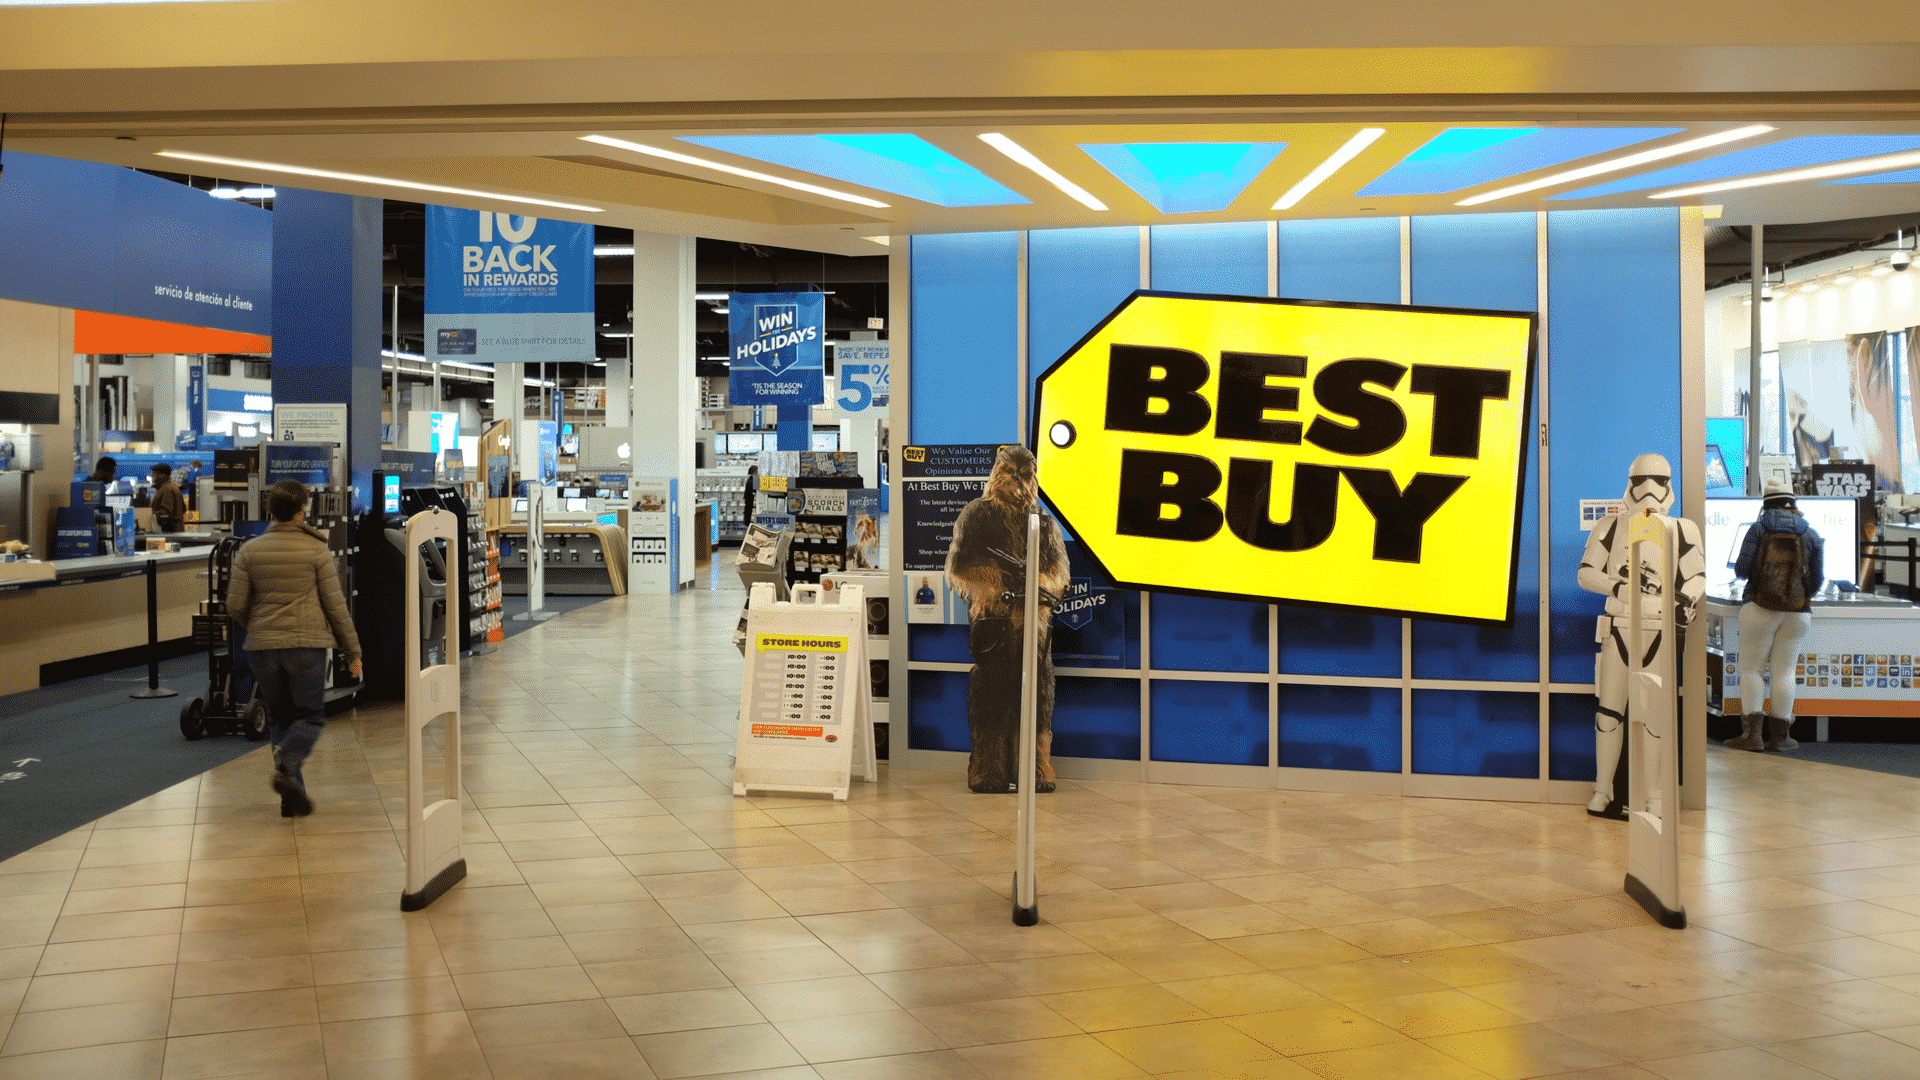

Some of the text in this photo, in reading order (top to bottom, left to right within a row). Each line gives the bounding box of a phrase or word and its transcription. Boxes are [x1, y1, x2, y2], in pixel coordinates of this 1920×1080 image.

[479, 210, 537, 243] 10
[463, 244, 558, 273] BACK
[463, 273, 559, 286] IN REWARDS
[155, 284, 253, 311] servicio de atención al cliente
[759, 311, 793, 332] WIN
[736, 326, 817, 360] HOLIDAYS
[863, 352, 890, 360] REPEA
[1104, 343, 1512, 460] BEST
[931, 447, 992, 455] We Value Our
[930, 457, 992, 465] CUSTOMERS
[925, 467, 992, 476] Opinions & Idea
[1816, 472, 1872, 487] STAR
[907, 482, 918, 491] At
[920, 482, 940, 491] Best
[942, 482, 960, 493] Buy
[963, 482, 978, 491] We
[1816, 485, 1872, 497] WARS
[1116, 447, 1471, 564] BUY
[756, 516, 791, 525] BUYER'S GUIDE
[1706, 512, 1730, 526] dle
[1072, 583, 1088, 595] IN
[1053, 594, 1106, 615] OLIDAYS
[801, 640, 842, 648] HOURS
